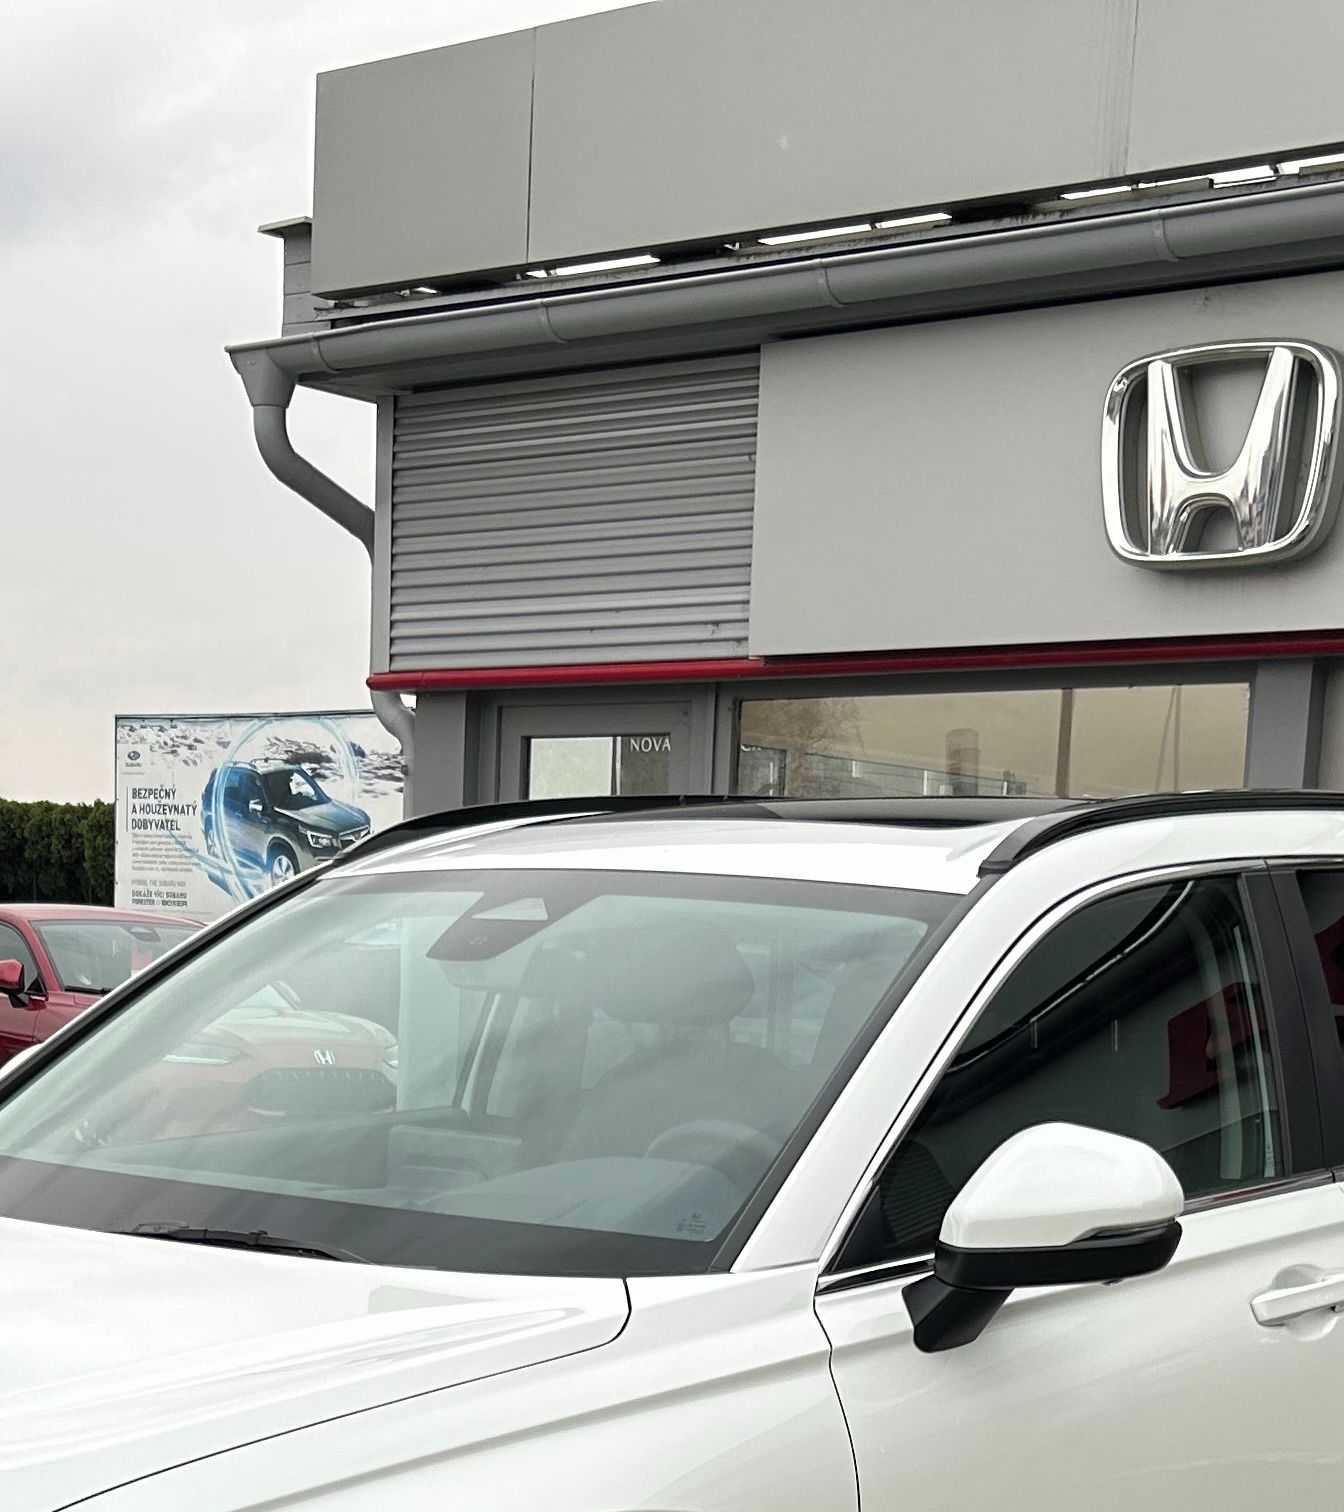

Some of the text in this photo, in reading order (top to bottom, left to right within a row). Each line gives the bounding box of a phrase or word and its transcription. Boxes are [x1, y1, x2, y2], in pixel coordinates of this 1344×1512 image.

[630, 737, 671, 752] NOVA
[131, 784, 177, 800] BEZPEČNÝ
[131, 800, 197, 816] A HOUŽEVNATÝ
[131, 818, 181, 831] DOBYVATEL
